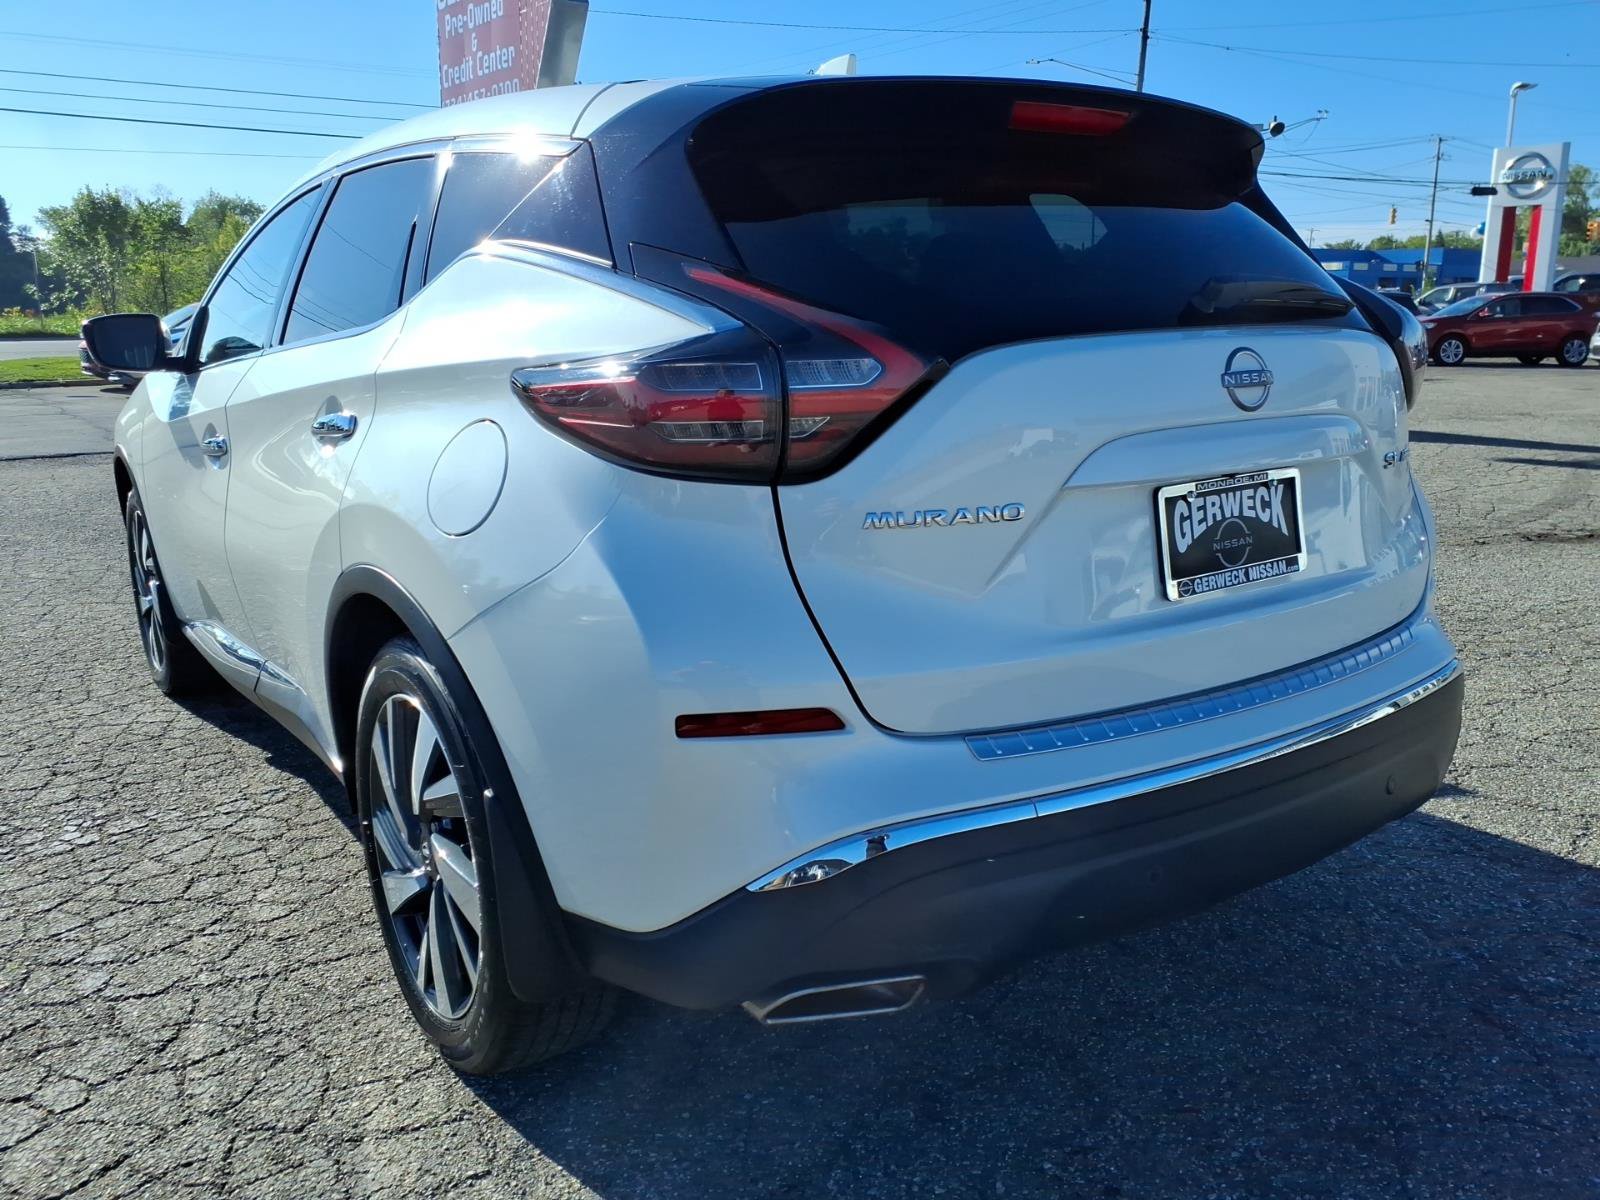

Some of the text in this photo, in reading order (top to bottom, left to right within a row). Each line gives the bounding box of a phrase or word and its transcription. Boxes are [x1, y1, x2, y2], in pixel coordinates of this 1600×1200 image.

[445, 0, 504, 39] Pre-Owned
[471, 32, 478, 52] &
[442, 45, 515, 89] Credit Center
[1502, 169, 1547, 181] NISSAN
[863, 502, 1025, 530] MURANO
[1174, 484, 1289, 553] GERWECK
[1213, 535, 1253, 551] NISSAN
[1194, 569, 1247, 593] GERWECK
